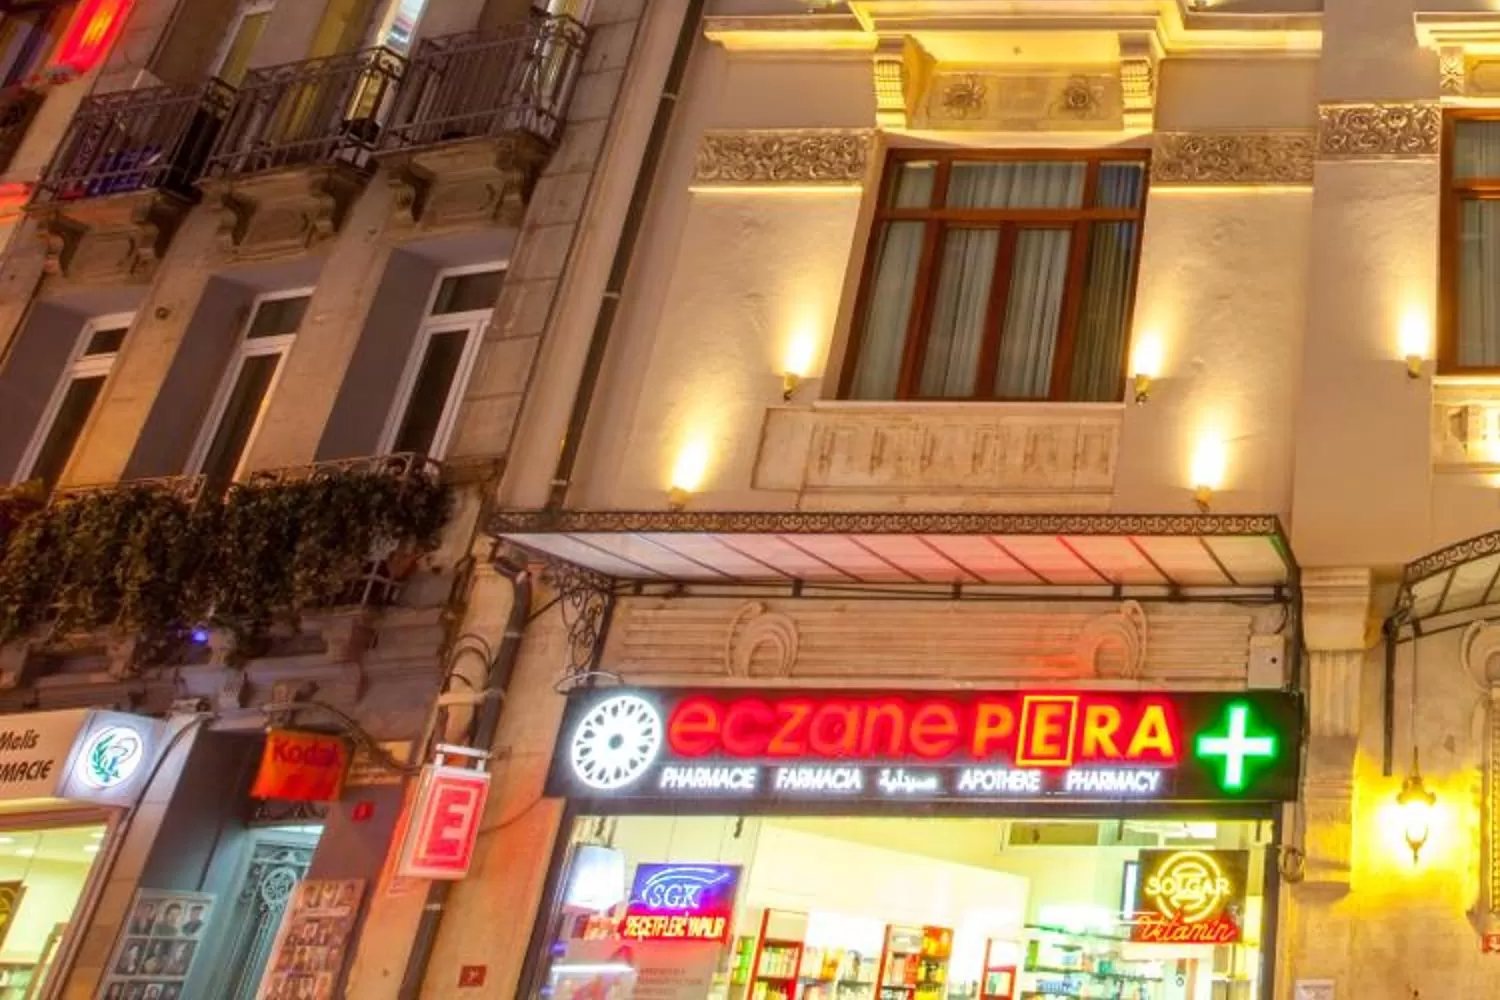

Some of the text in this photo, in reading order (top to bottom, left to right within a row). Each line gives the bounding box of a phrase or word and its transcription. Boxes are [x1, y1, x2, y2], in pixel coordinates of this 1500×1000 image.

[669, 699, 1175, 758] eczane PERA
[660, 766, 863, 791] PHARMACIE FARMACIA
[958, 769, 1161, 792] APOTHEKE PHARMACY
[648, 883, 702, 909] SGK
[1143, 876, 1231, 897] SOLGAR
